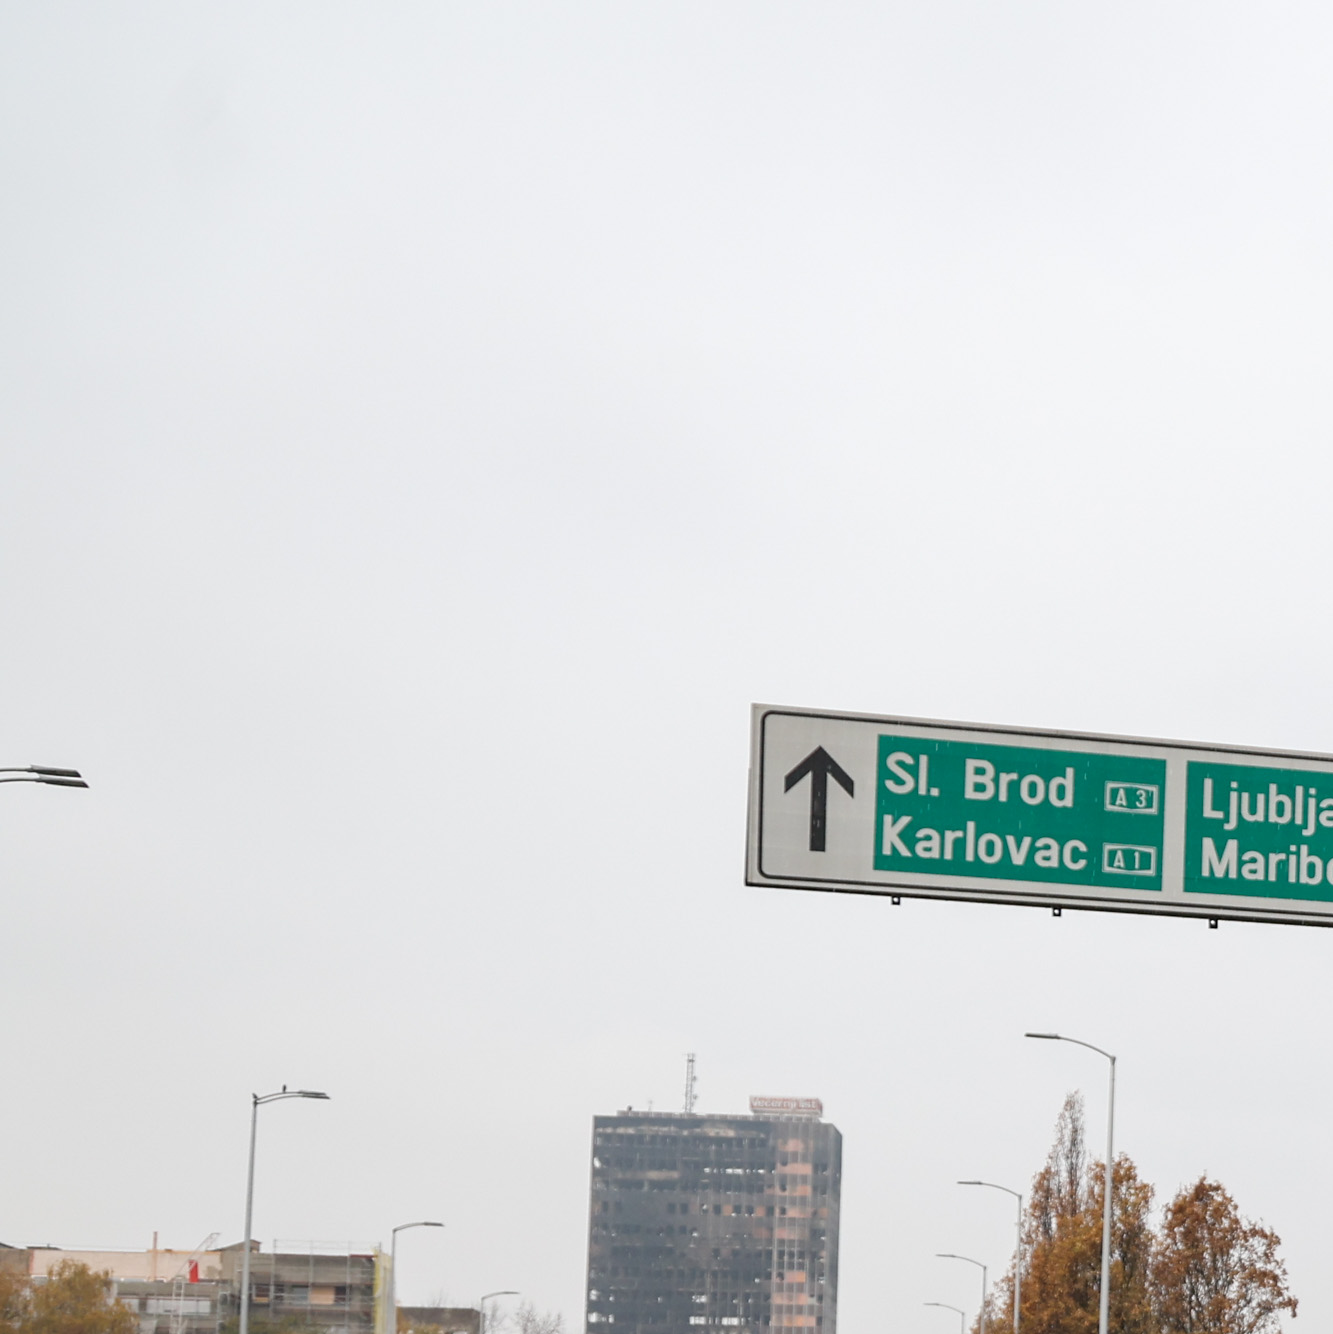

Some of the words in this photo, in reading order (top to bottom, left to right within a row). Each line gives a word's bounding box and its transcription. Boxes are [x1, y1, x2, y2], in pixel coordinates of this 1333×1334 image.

[884, 751, 940, 797] Sl.
[964, 758, 1075, 808] Brod
[882, 814, 1088, 871] Karlovac
